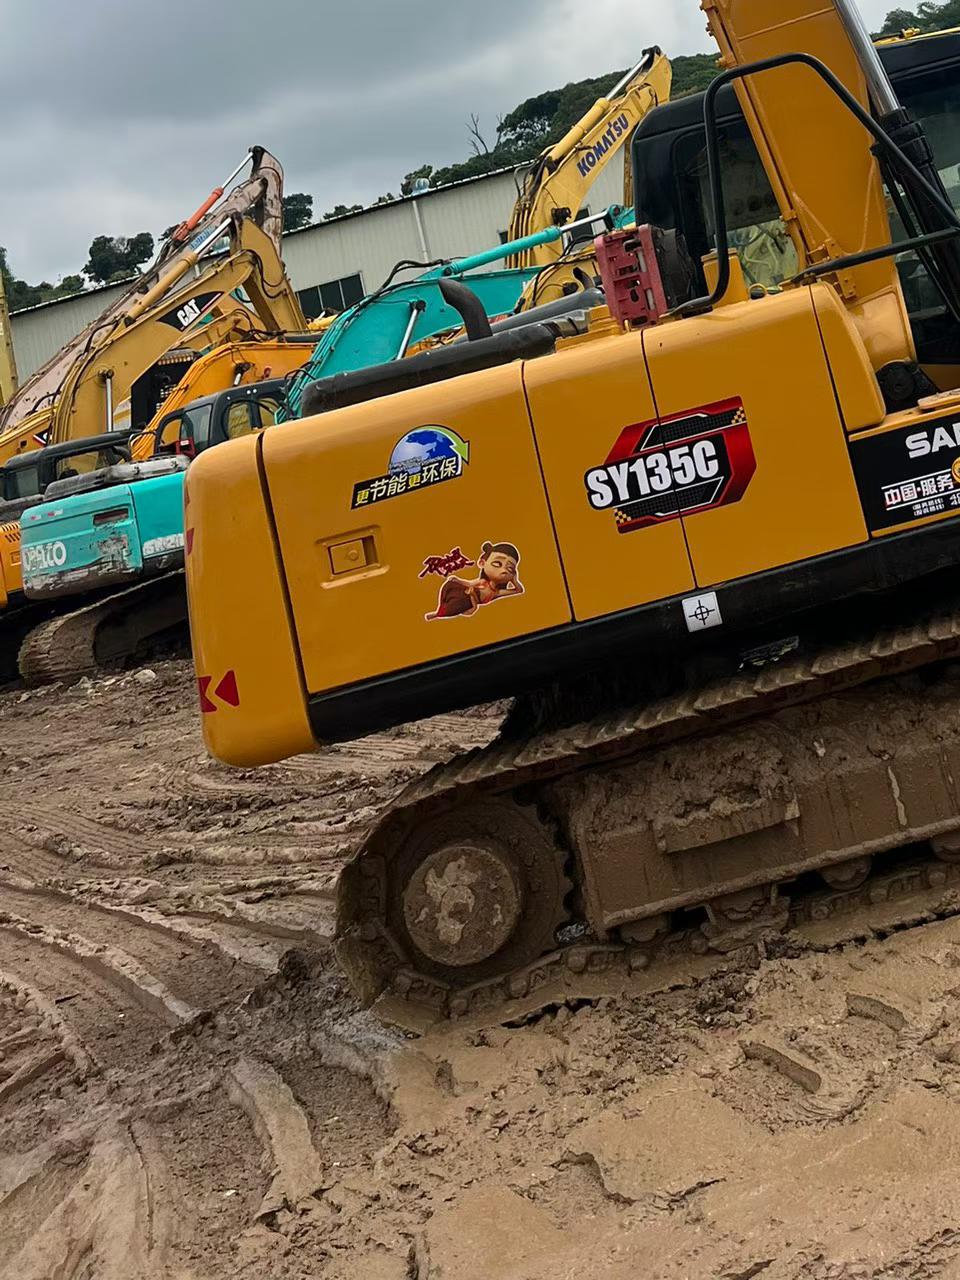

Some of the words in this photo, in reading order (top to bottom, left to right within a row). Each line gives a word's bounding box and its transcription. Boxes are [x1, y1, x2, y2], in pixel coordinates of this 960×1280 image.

[577, 113, 629, 177] KOMATSU
[177, 299, 201, 327] CAT
[355, 456, 457, 507] 更节能更环保
[587, 440, 719, 507] SY135C
